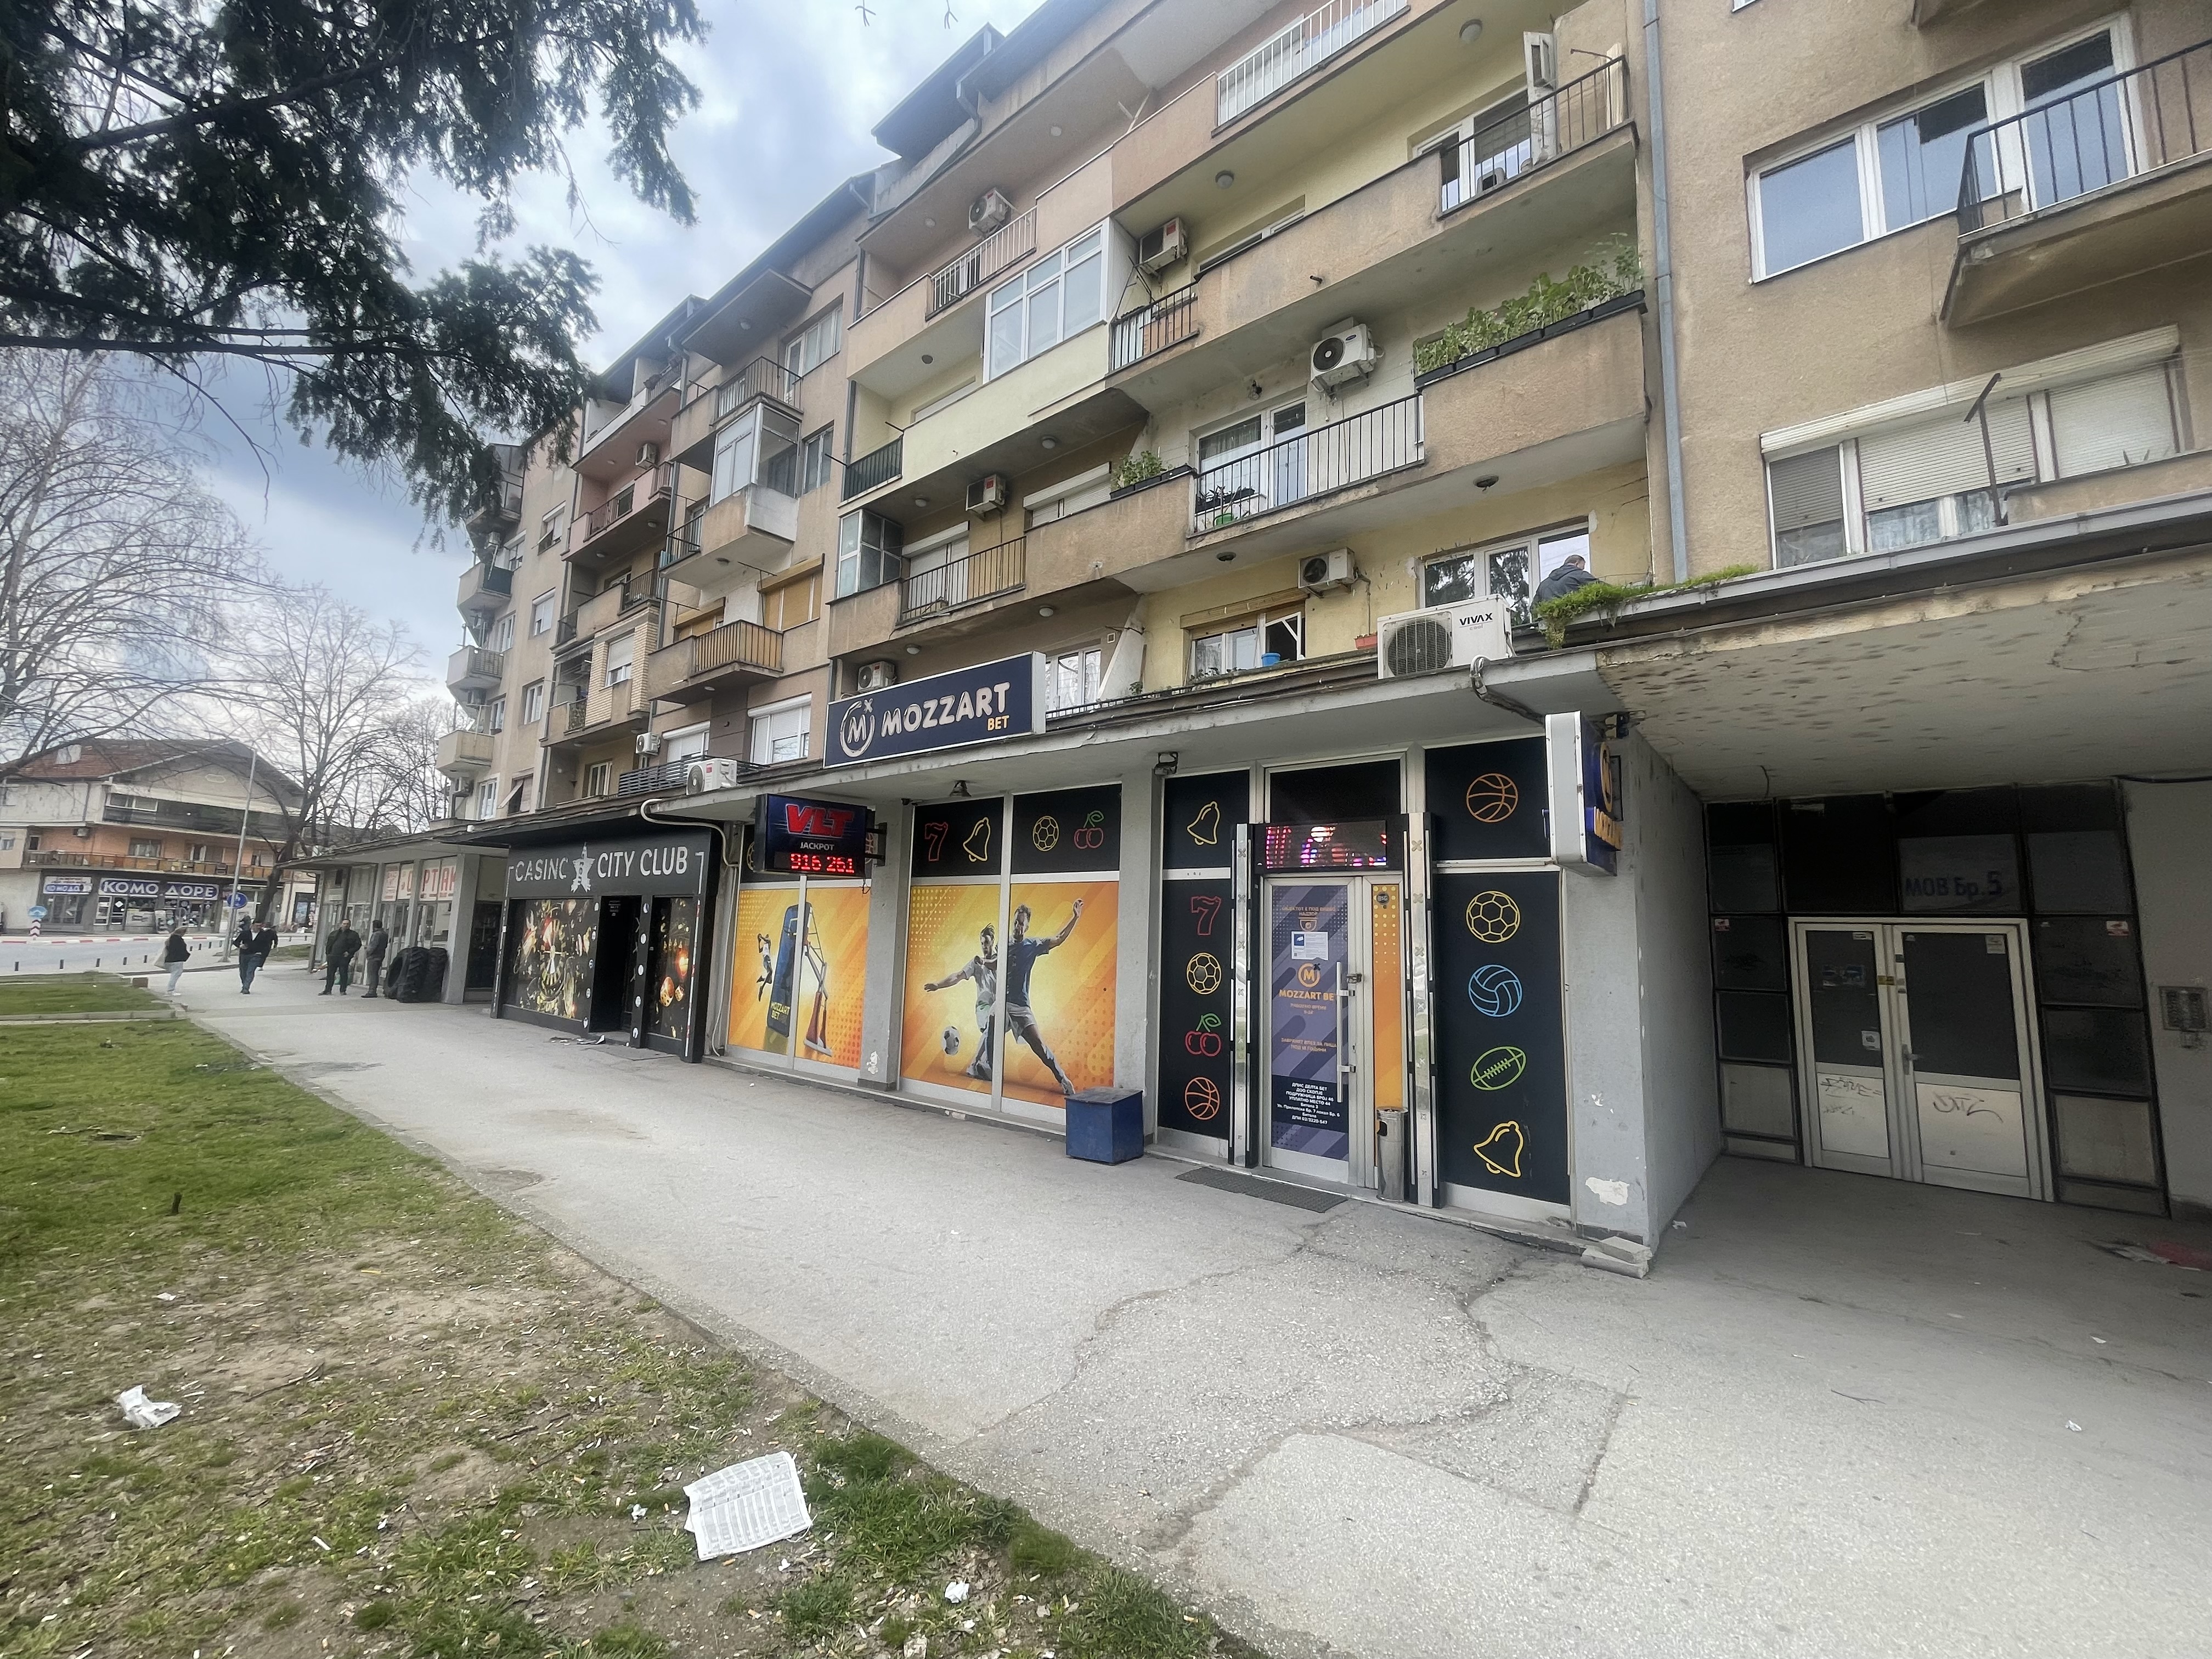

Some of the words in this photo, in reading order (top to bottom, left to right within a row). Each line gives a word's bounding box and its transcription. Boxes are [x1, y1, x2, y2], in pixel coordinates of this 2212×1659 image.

[1459, 613, 1493, 625] VIVAX
[881, 682, 1010, 737] MOZZART
[988, 715, 1009, 731] BET
[786, 804, 854, 838] VLT
[800, 842, 835, 851] JACKPOT
[597, 850, 635, 878] CITY
[640, 846, 688, 876] CLUB
[1279, 989, 1322, 1000] MOZZART
[1323, 992, 1336, 1001] BE
